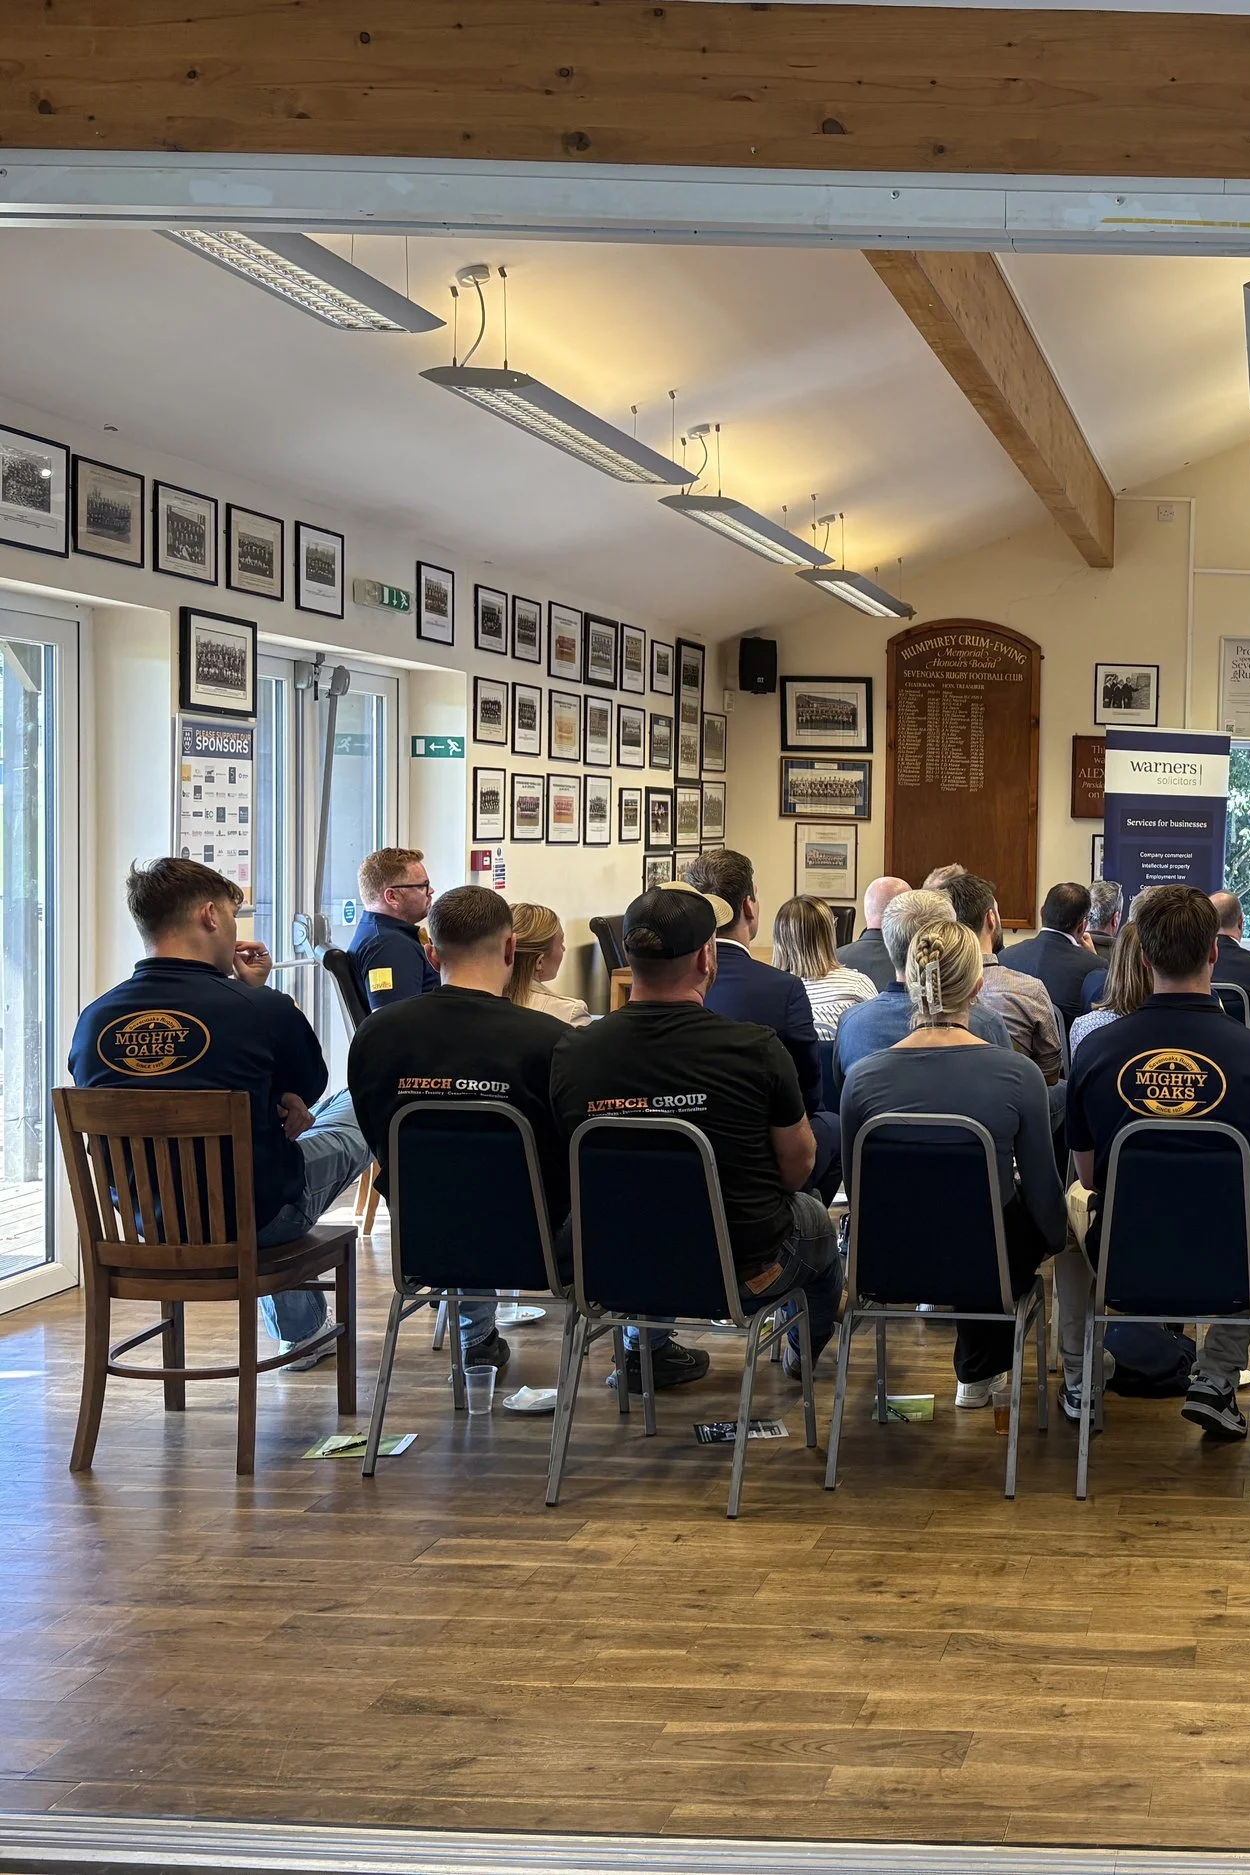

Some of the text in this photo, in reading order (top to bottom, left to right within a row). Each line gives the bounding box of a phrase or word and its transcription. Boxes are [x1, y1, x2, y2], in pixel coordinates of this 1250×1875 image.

[900, 634, 1028, 665] HUMPHREY CRUM-EWING
[937, 647, 989, 661] Memorial
[926, 657, 1002, 670] Honours Board
[903, 670, 1024, 681] SEVENOAKS RUGBY FOOTBALL CLUB
[195, 729, 216, 739] PLEASE
[216, 731, 240, 740] SUPPORT
[195, 737, 249, 754] SPONSORS
[1130, 760, 1197, 775] warners
[1156, 777, 1197, 786] solicitors
[1126, 818, 1208, 828] Services for businesses
[1139, 851, 1164, 859] Company
[1145, 873, 1177, 881] Employment
[114, 1030, 190, 1045] MIGHTY
[125, 1043, 175, 1057] OAKS
[1148, 1056, 1195, 1071] Sevenoaks Rugby
[397, 1077, 510, 1093] AZTECH GROUP
[1135, 1072, 1208, 1087] MIGHTY
[1146, 1086, 1195, 1100] OAKS
[587, 1098, 649, 1113] AZTECH
[652, 1093, 708, 1108] GROUP
[1155, 1105, 1171, 1113] SINCE
